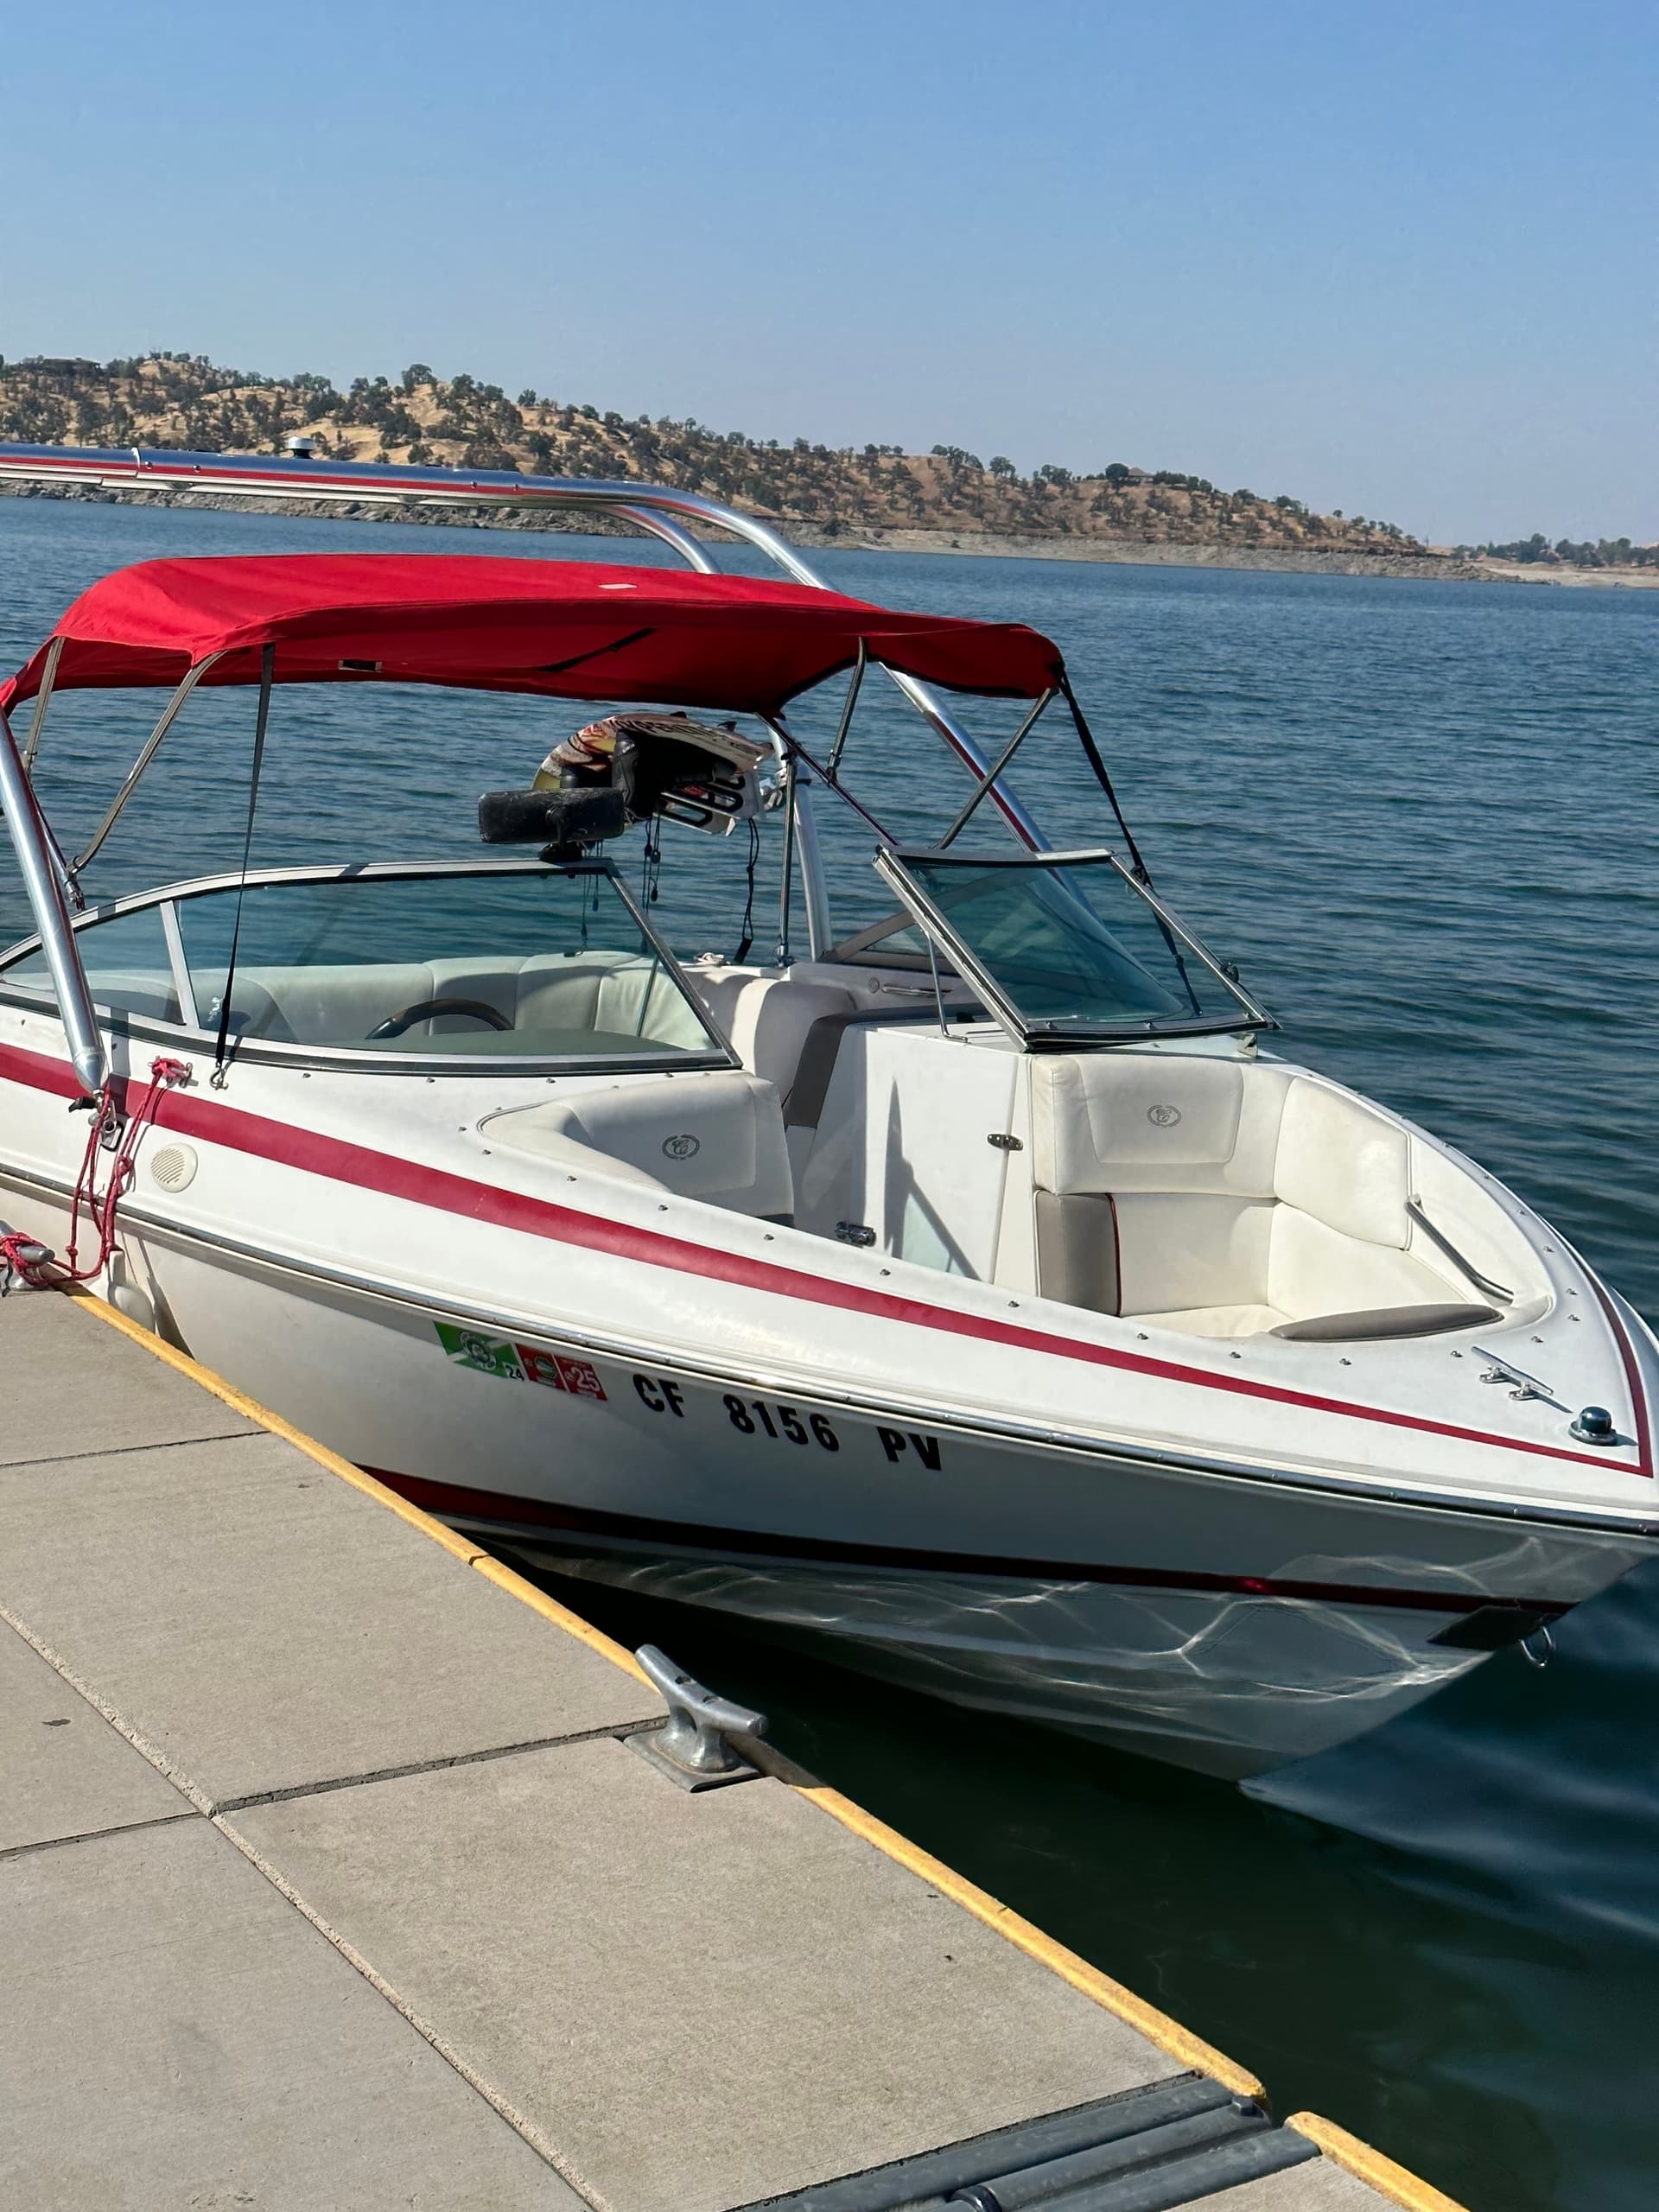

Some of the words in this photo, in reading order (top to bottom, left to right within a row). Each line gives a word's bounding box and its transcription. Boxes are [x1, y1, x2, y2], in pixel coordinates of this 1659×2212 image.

[505, 1364, 524, 1381] 24
[570, 1366, 601, 1392] 25
[632, 1374, 684, 1417] CF
[722, 1394, 840, 1452] 8156
[876, 1427, 942, 1471] PV
